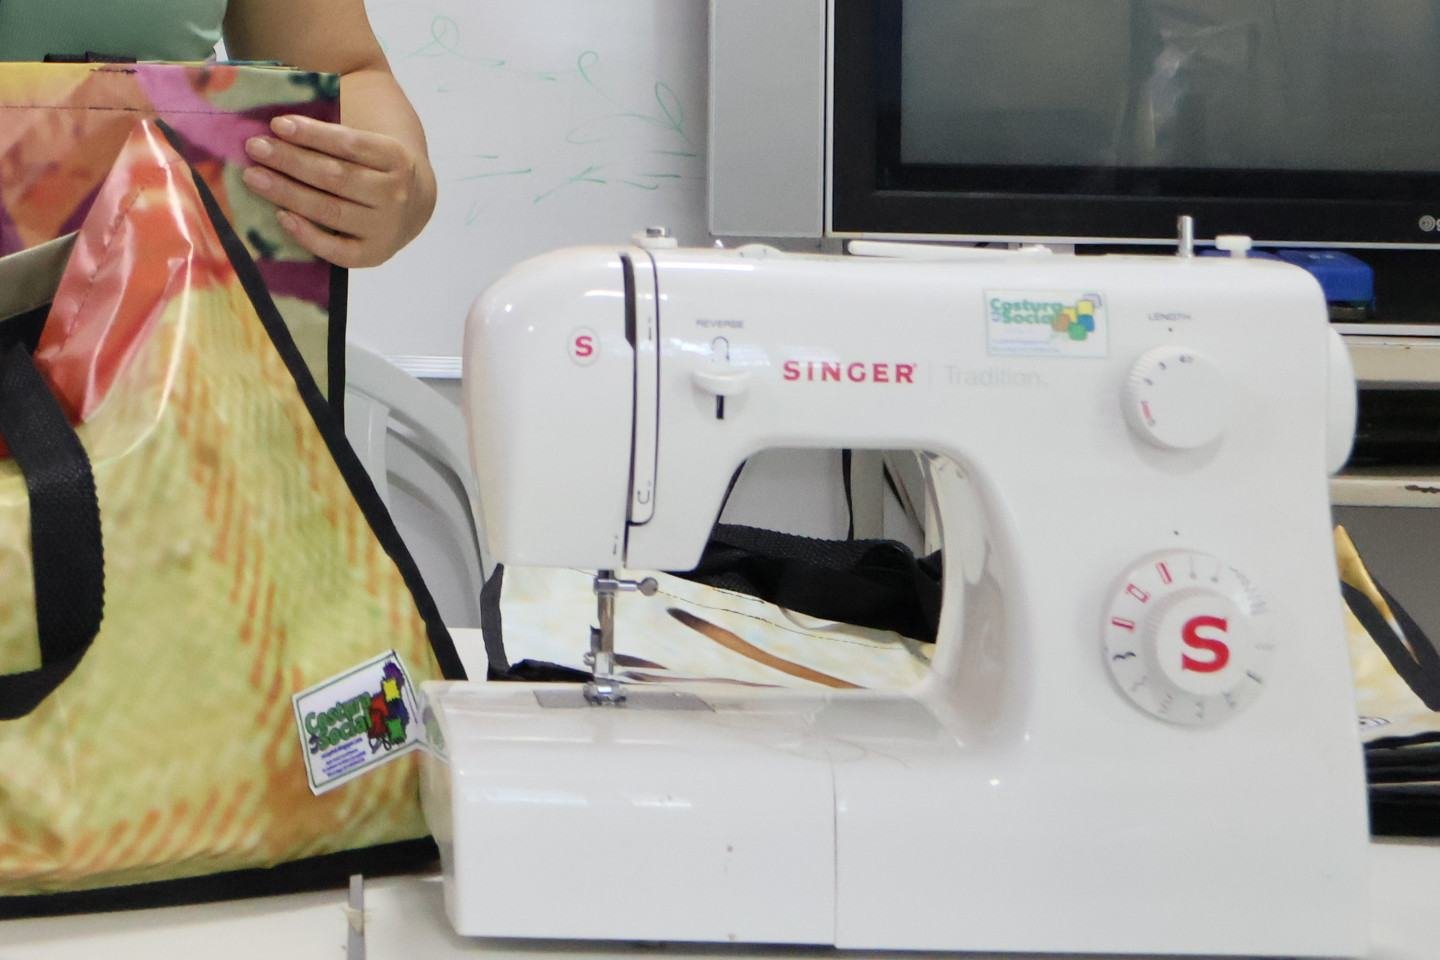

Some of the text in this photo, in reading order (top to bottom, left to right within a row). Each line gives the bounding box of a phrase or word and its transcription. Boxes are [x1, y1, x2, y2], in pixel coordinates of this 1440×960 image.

[575, 336, 593, 356] S
[783, 360, 916, 384] SINGER
[1182, 615, 1230, 673] S
